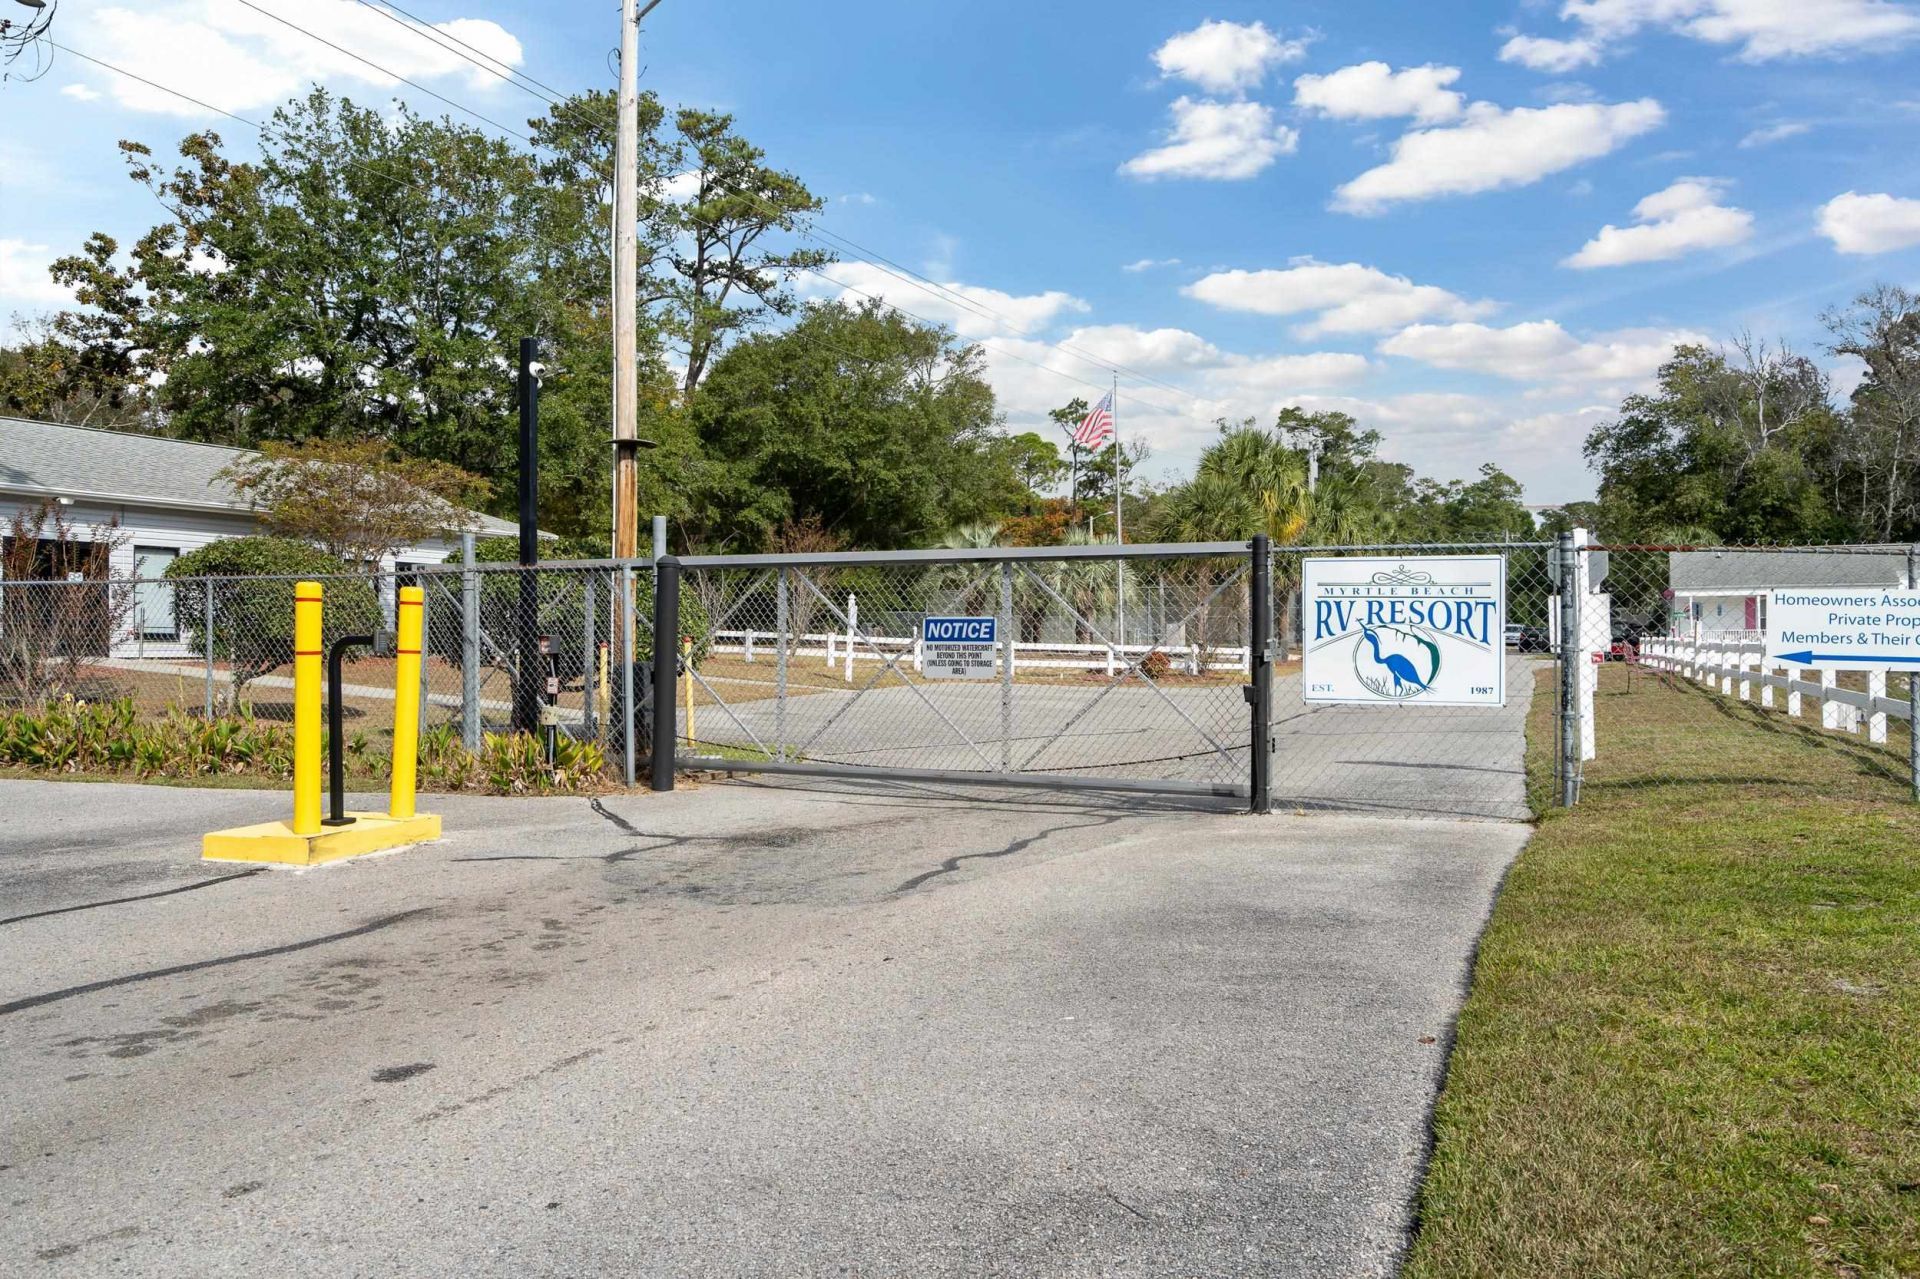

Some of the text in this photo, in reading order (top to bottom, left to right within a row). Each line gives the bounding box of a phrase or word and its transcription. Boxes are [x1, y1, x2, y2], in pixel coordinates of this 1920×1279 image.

[1775, 594, 1876, 606] Homeowners
[1314, 600, 1496, 645] RV RESORT
[1829, 613, 1920, 629] Private Prop
[928, 622, 992, 638] NOTICE
[1782, 632, 1852, 644] Members
[1857, 633, 1868, 645] &
[1872, 633, 1911, 645] Their
